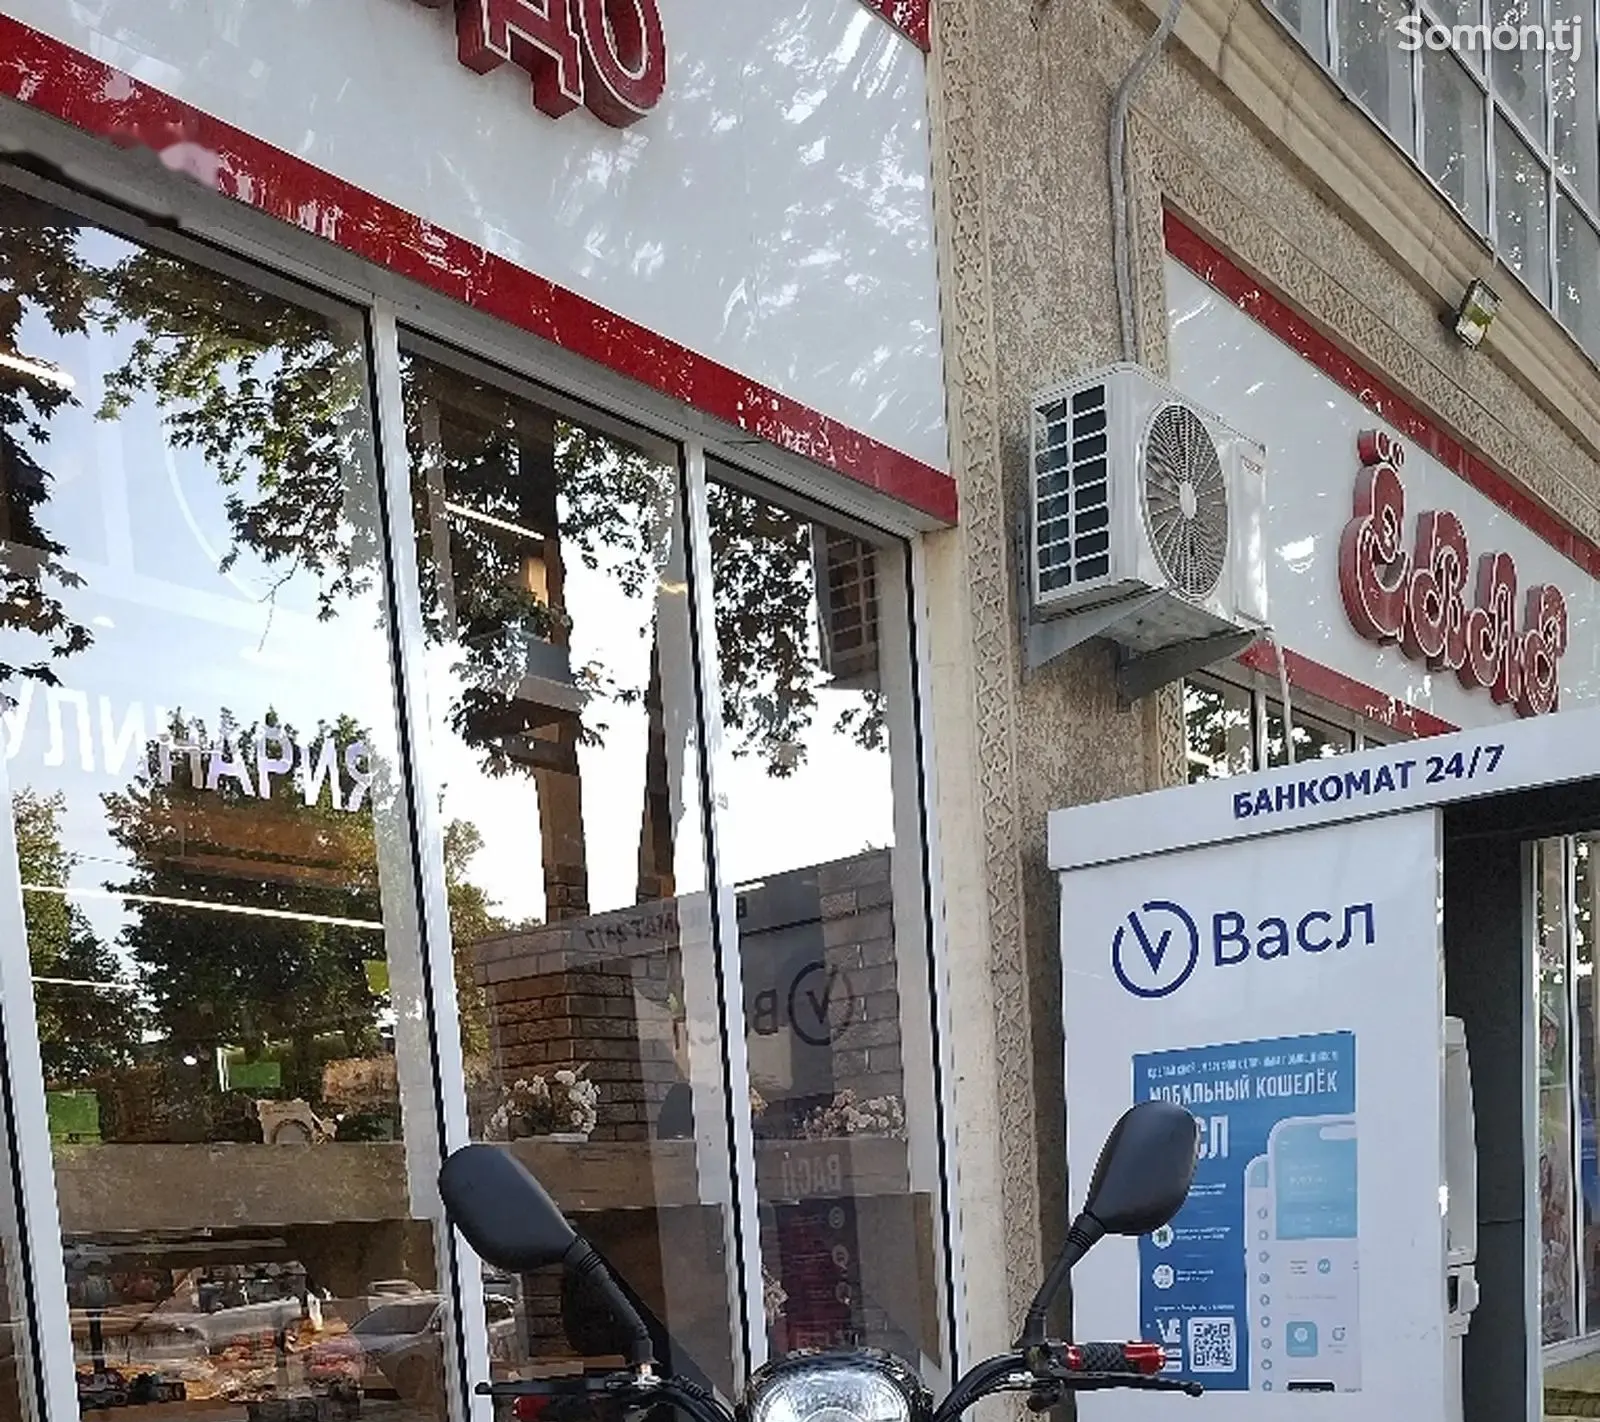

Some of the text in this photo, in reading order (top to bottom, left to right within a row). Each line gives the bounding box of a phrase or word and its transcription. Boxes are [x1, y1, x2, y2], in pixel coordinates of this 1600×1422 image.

[1233, 744, 1505, 819] БАНКОМАТ 24/7
[1212, 903, 1376, 967] Васл
[1149, 1070, 1338, 1106] МОБИЛЬНЫЙ КОШЕЛЁК
[1195, 1115, 1229, 1160] СЛ
